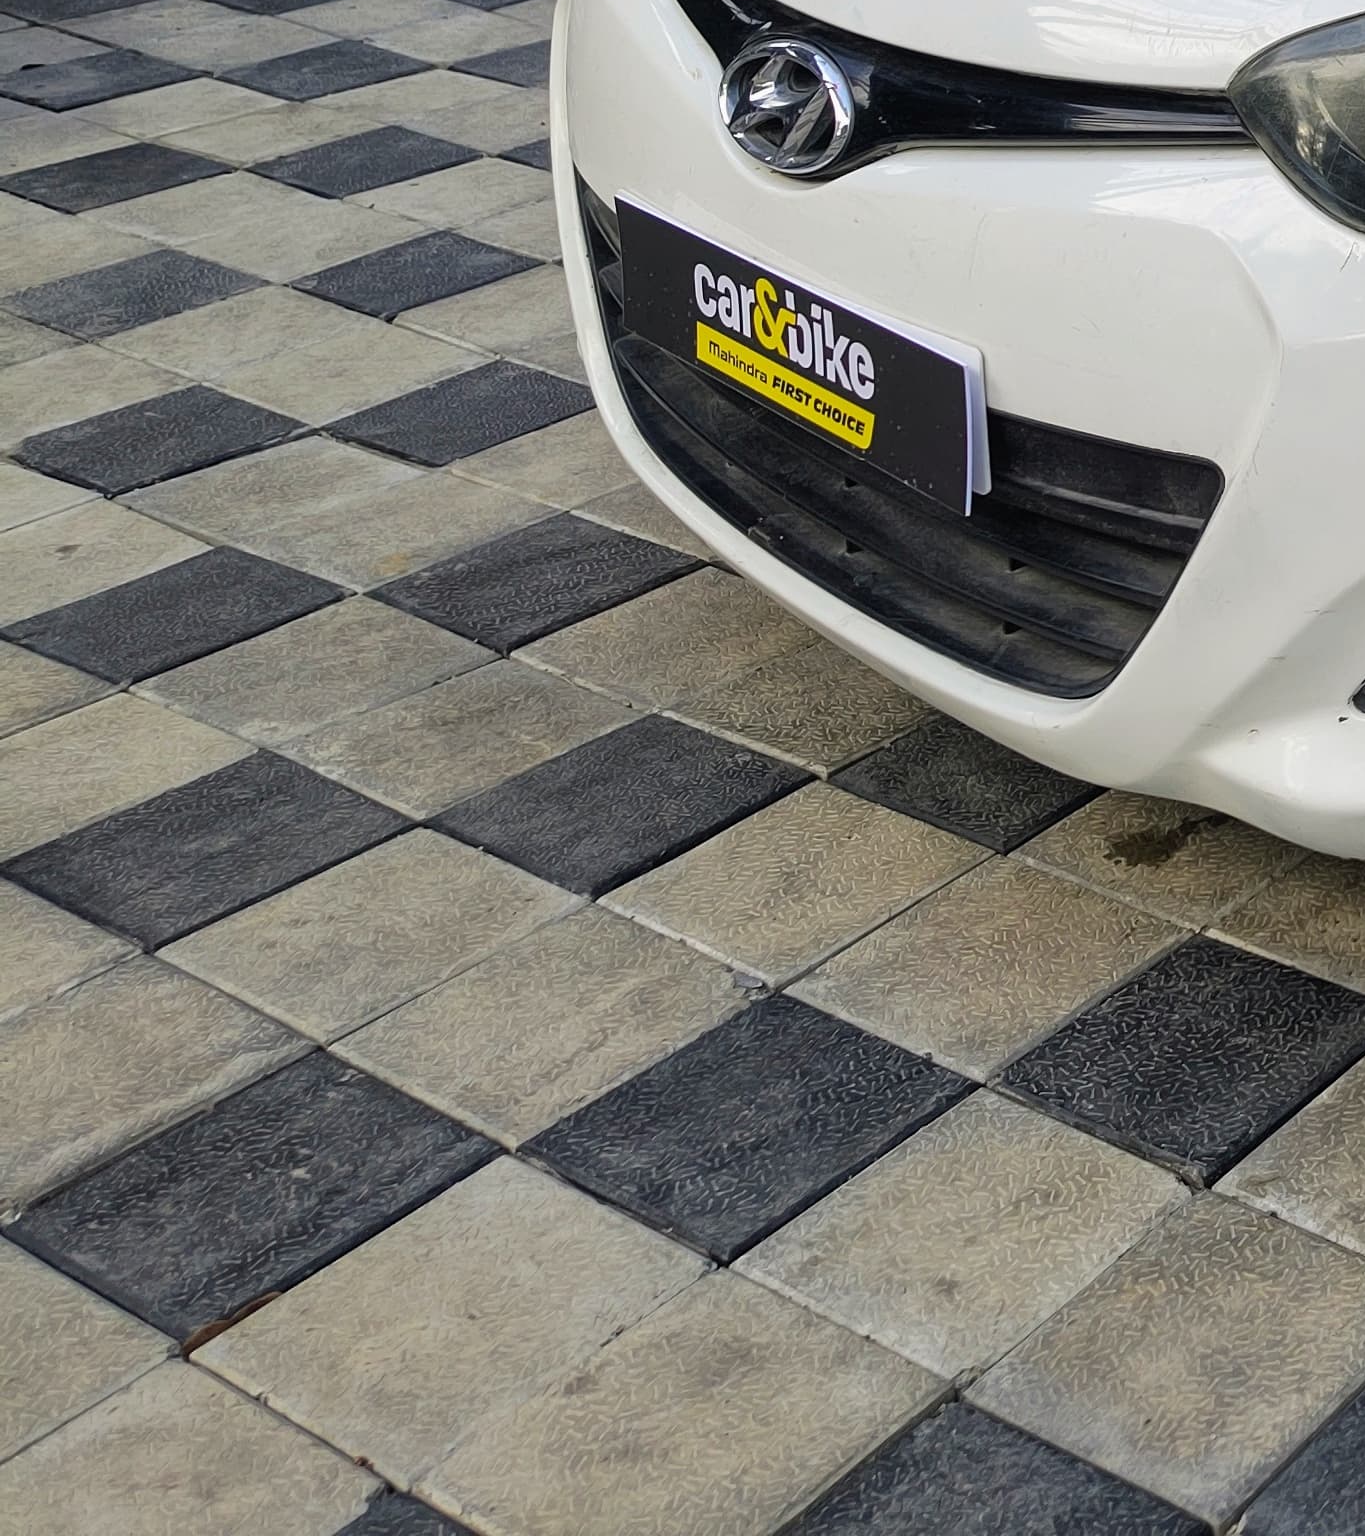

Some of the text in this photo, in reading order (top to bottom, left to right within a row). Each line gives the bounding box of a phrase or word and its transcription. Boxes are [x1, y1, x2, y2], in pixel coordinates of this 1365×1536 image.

[694, 263, 876, 401] car&bike
[771, 374, 813, 407] FIRST
[812, 397, 866, 436] CHOICE
